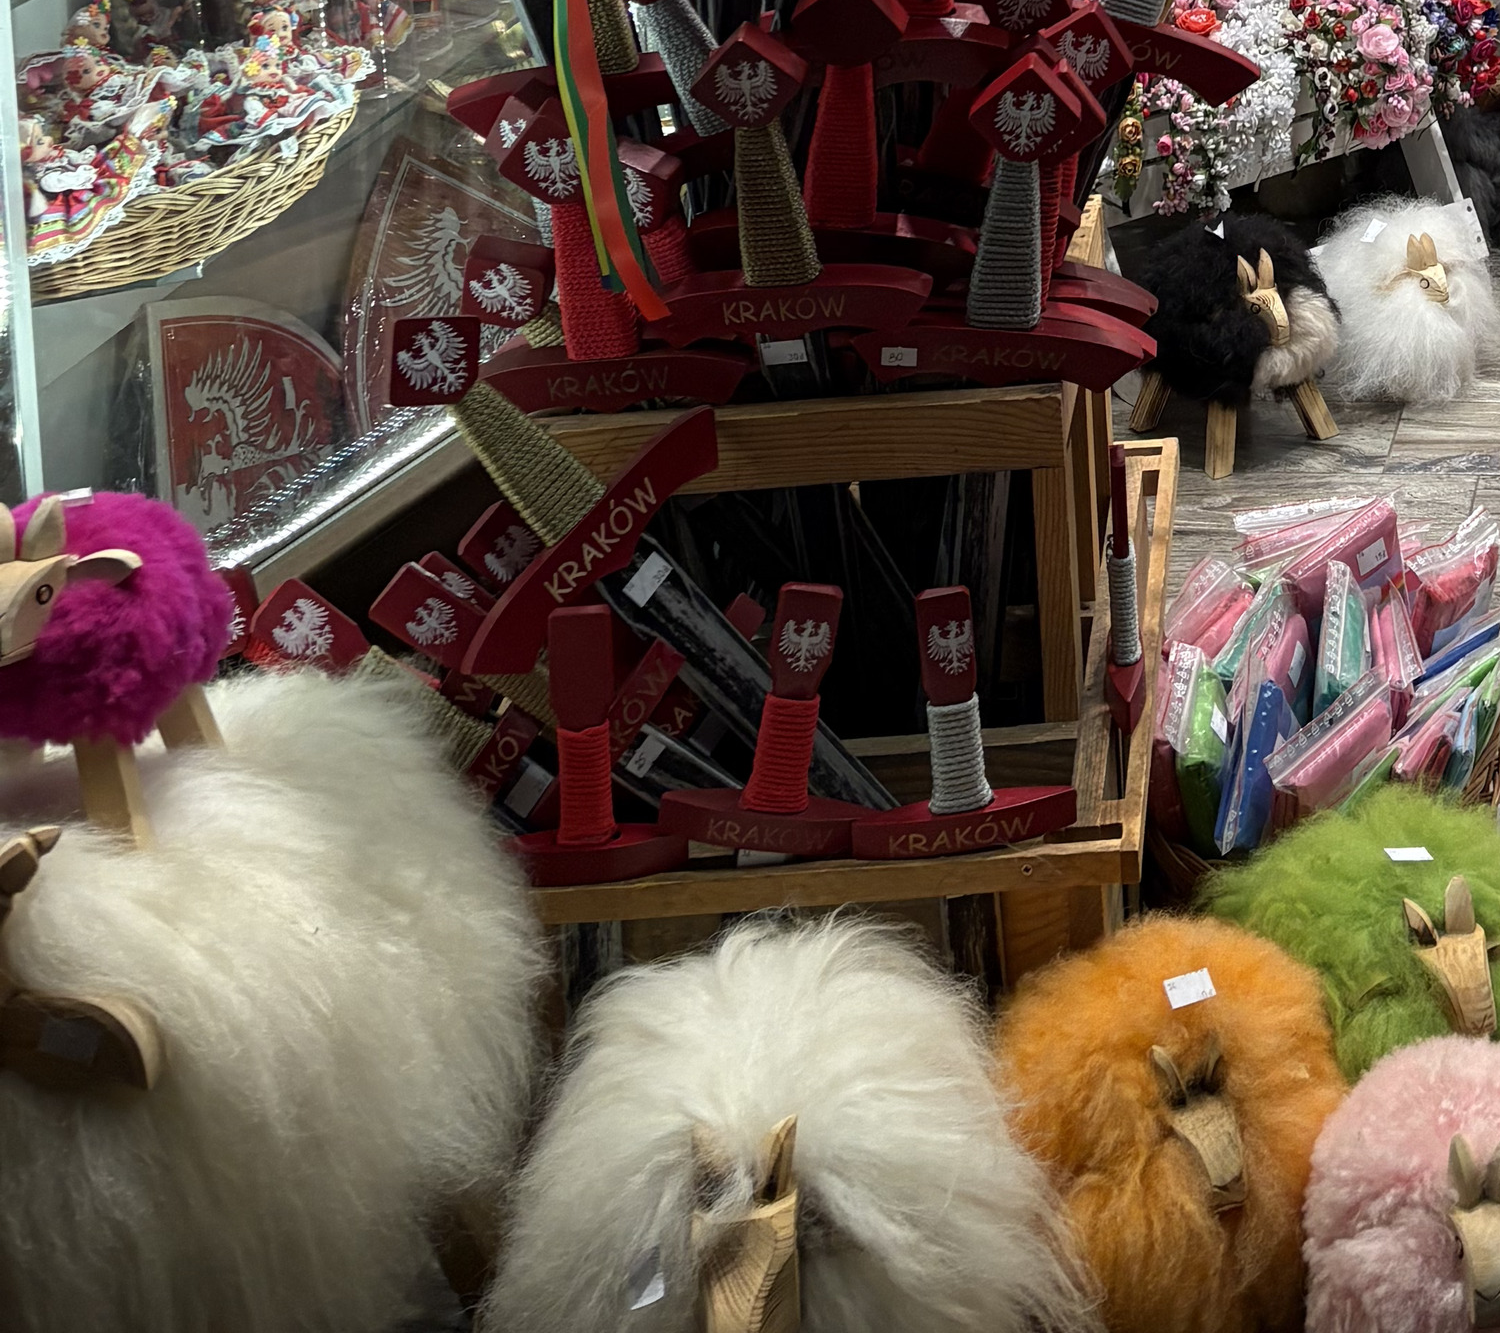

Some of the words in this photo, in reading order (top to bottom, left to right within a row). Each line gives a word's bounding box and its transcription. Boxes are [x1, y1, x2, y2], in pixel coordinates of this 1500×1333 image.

[721, 293, 847, 326] KRAKÓW
[932, 343, 1067, 373] KRAKÓW
[546, 364, 669, 401] KRAKÓW
[542, 477, 658, 603] KRAKÓW
[888, 812, 1035, 857] KRAKÓW
